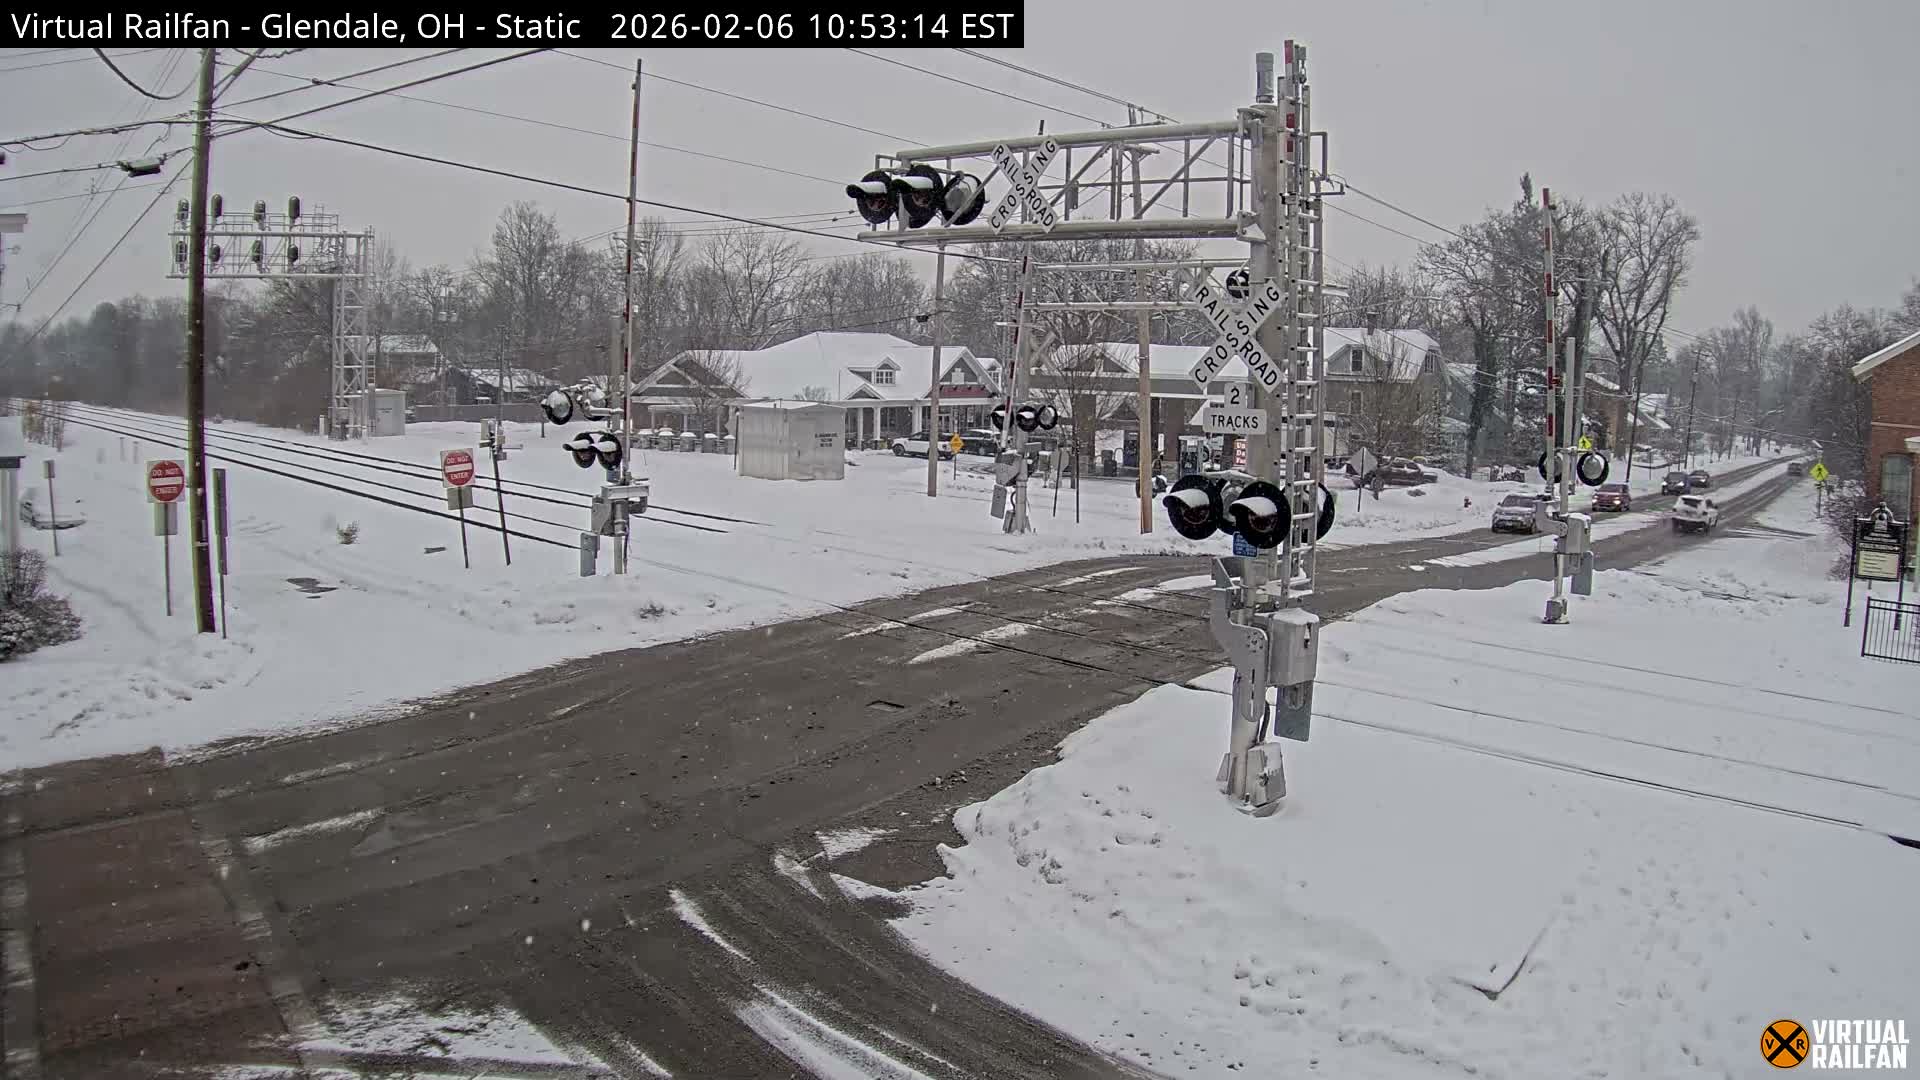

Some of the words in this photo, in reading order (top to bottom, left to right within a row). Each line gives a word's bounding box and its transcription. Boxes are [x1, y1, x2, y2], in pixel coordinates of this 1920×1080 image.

[991, 141, 1056, 229] CROSSING
[1194, 286, 1280, 383] CROSSING
[1230, 387, 1240, 405] 2
[1211, 414, 1259, 429] TRACKS
[450, 472, 468, 480] ENTER
